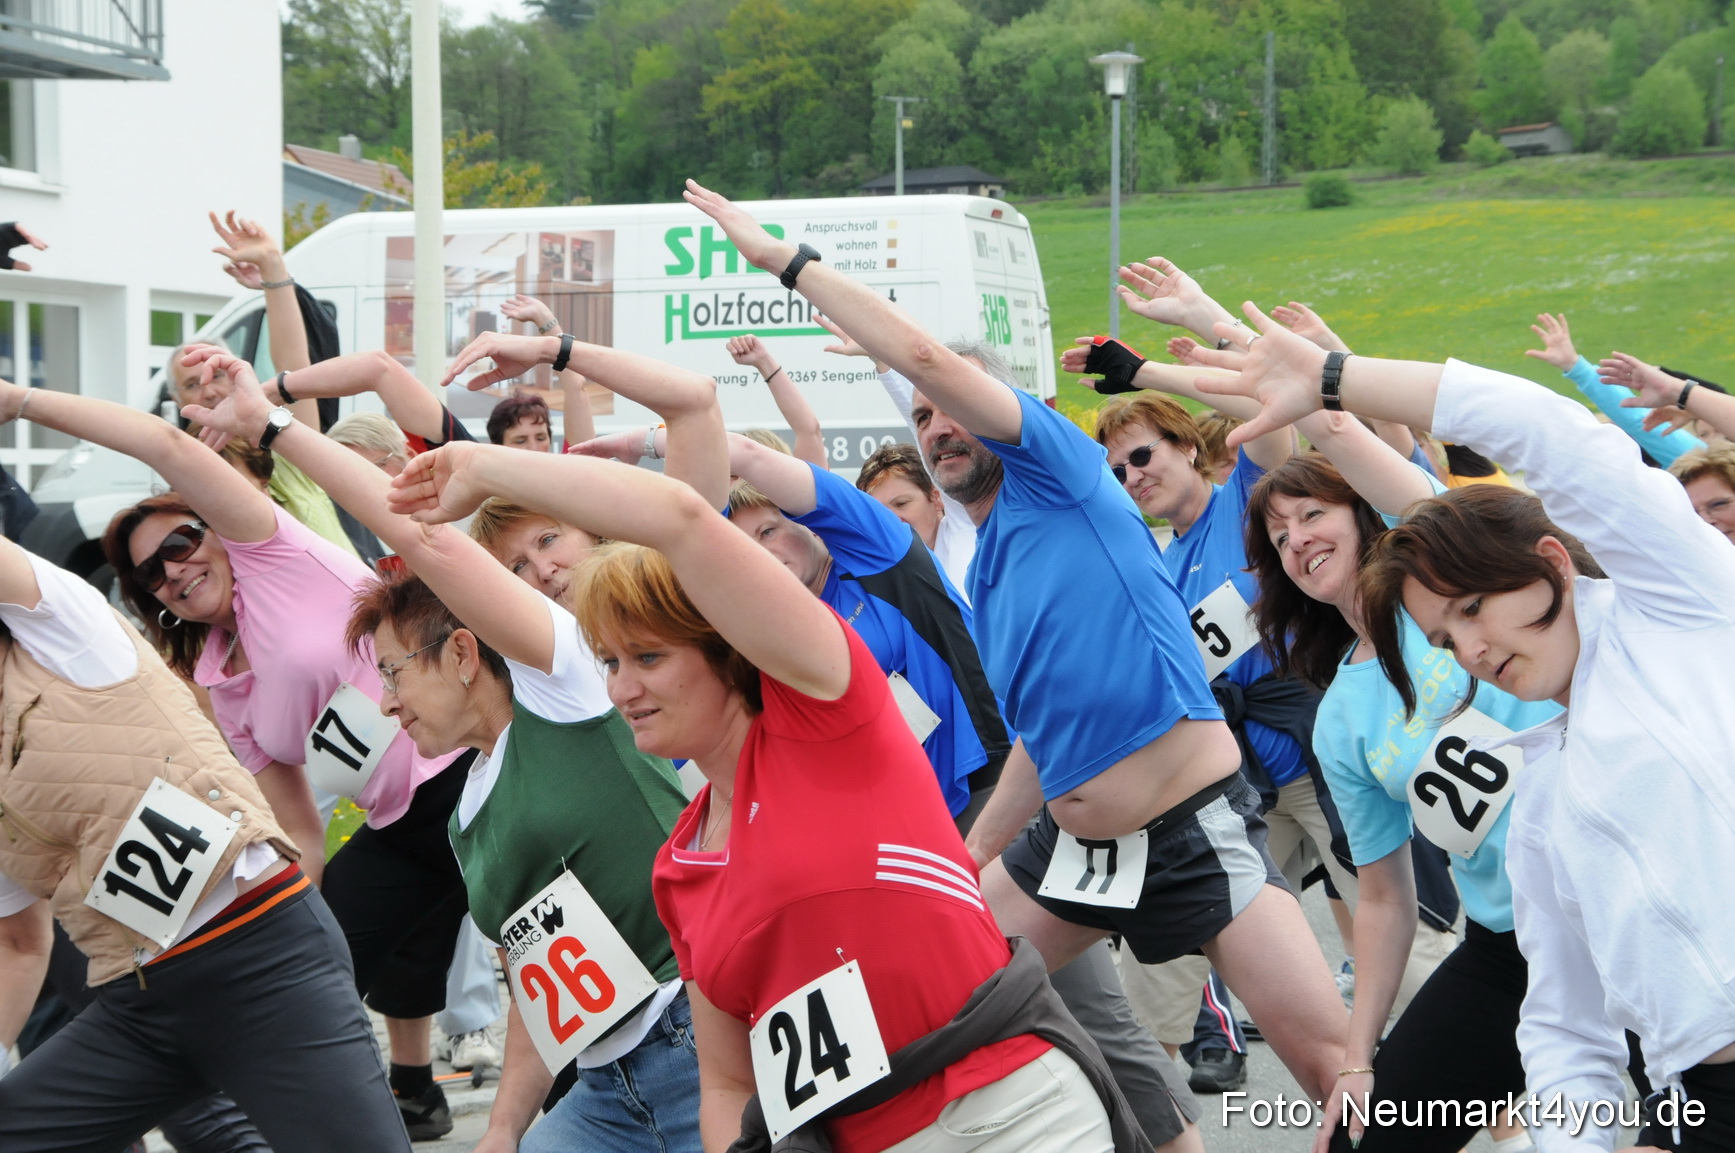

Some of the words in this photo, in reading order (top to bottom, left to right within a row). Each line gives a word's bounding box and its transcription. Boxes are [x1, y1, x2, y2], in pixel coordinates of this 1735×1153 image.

[804, 219, 878, 235] Anspruchsvoll
[836, 240, 878, 251] wohnen
[834, 258, 852, 271] mit
[854, 258, 877, 270] Holz
[982, 294, 1012, 349] SHB
[752, 372, 760, 384] 7
[821, 370, 880, 384] Sengent
[312, 707, 371, 772] 17
[1414, 735, 1509, 833] 26
[103, 806, 212, 917] 124
[508, 929, 542, 966] ERBUNG
[519, 935, 616, 1045] 26
[768, 988, 852, 1112] 24
